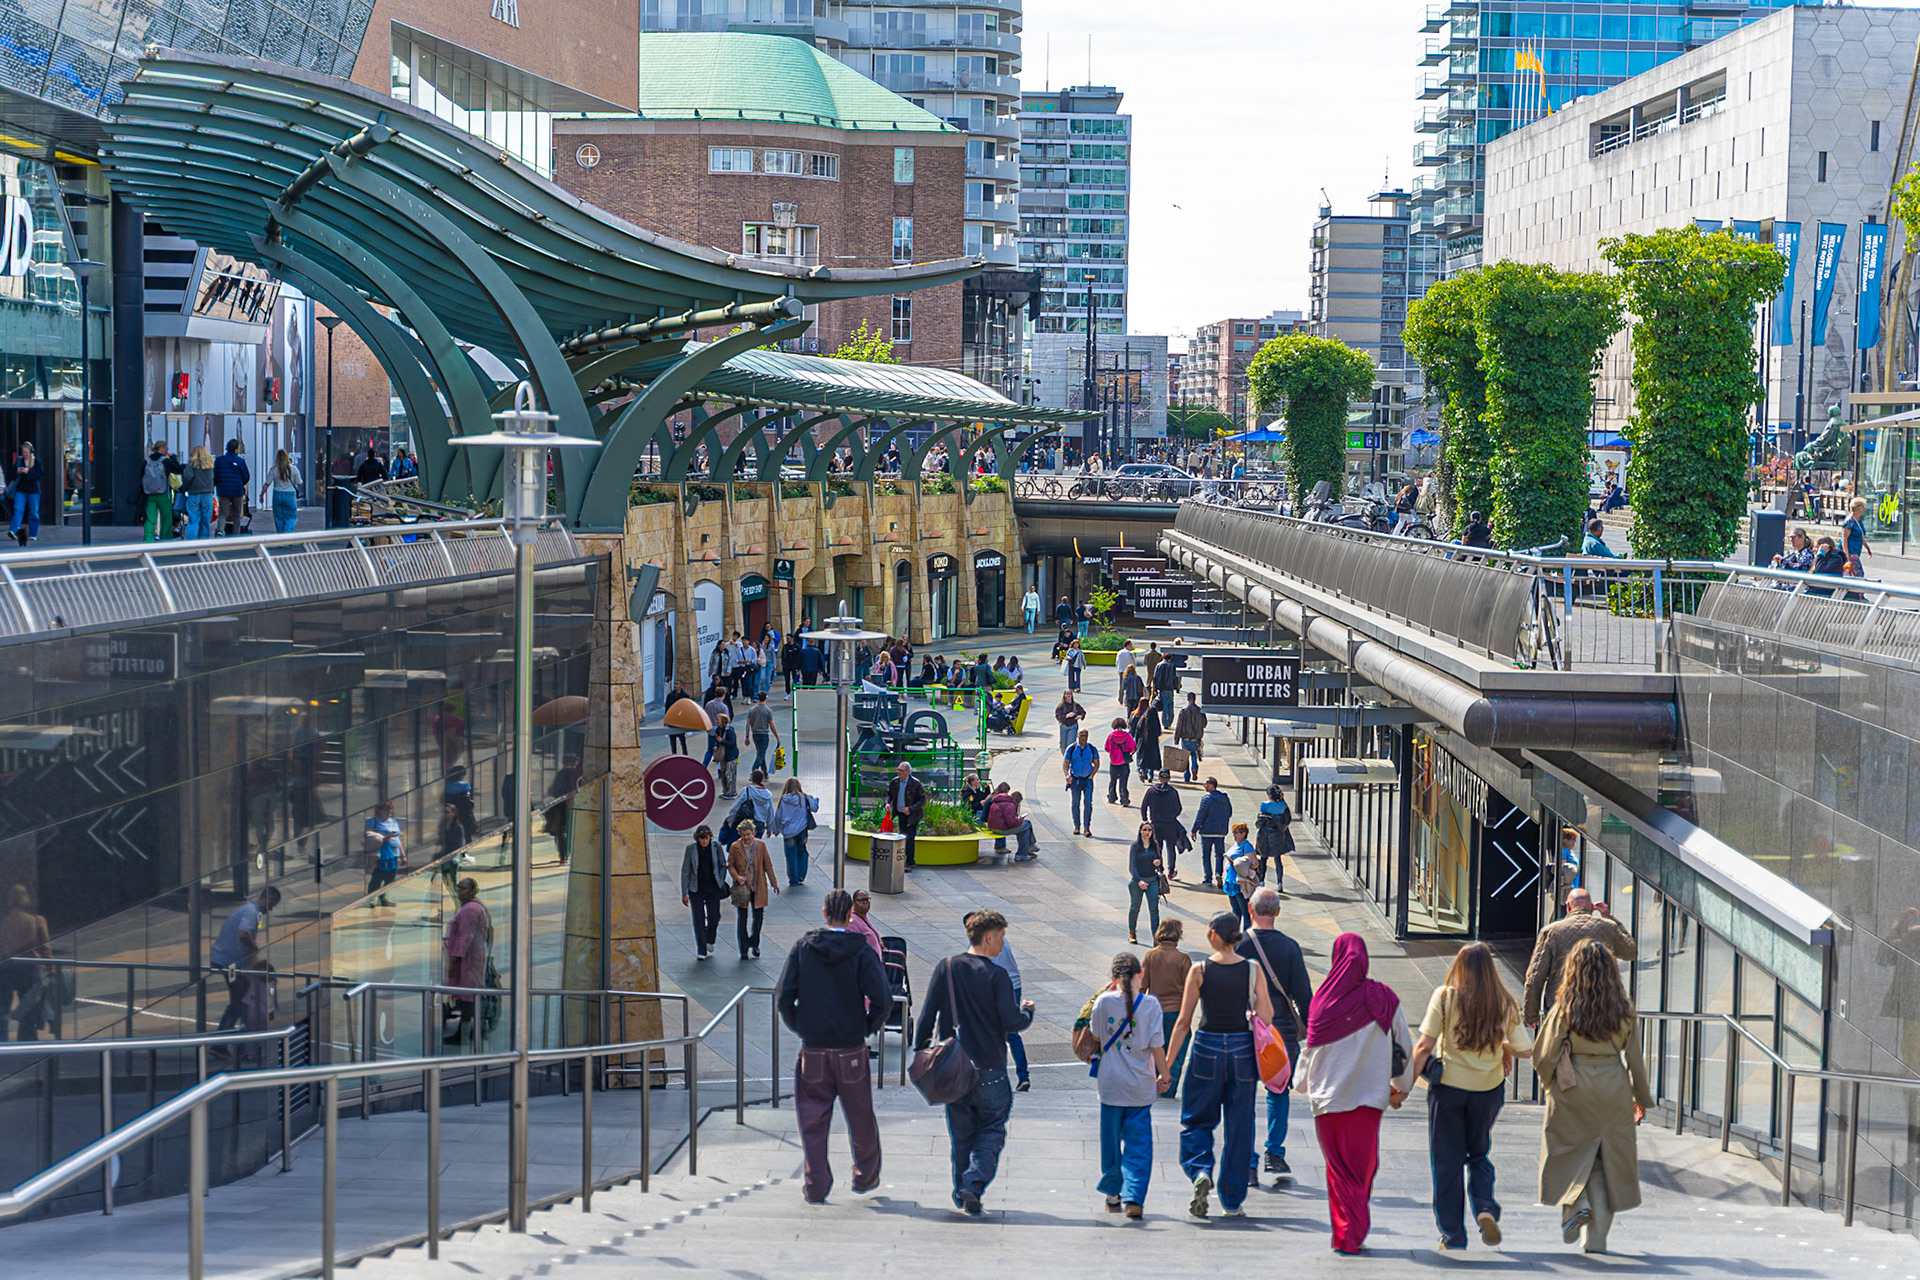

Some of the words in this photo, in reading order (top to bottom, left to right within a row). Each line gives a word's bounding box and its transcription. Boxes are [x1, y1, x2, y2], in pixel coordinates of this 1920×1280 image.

[1777, 232, 1785, 248] WTC
[1821, 234, 1829, 250] WTC
[1864, 234, 1872, 250] WTC
[1825, 234, 1836, 268] WELCOME
[1869, 235, 1879, 268] WELCOME
[1816, 250, 1827, 291] ROTTERDAM
[1823, 268, 1831, 279] TO
[1862, 250, 1870, 292] ROTTERDAM
[1868, 269, 1875, 280] TO
[933, 556, 948, 568] KIKO
[1140, 588, 1167, 597] URBAN
[1140, 599, 1188, 609] OUTFITTERS
[1246, 664, 1292, 680] URBAN
[1210, 682, 1291, 698] OUTFITTERS
